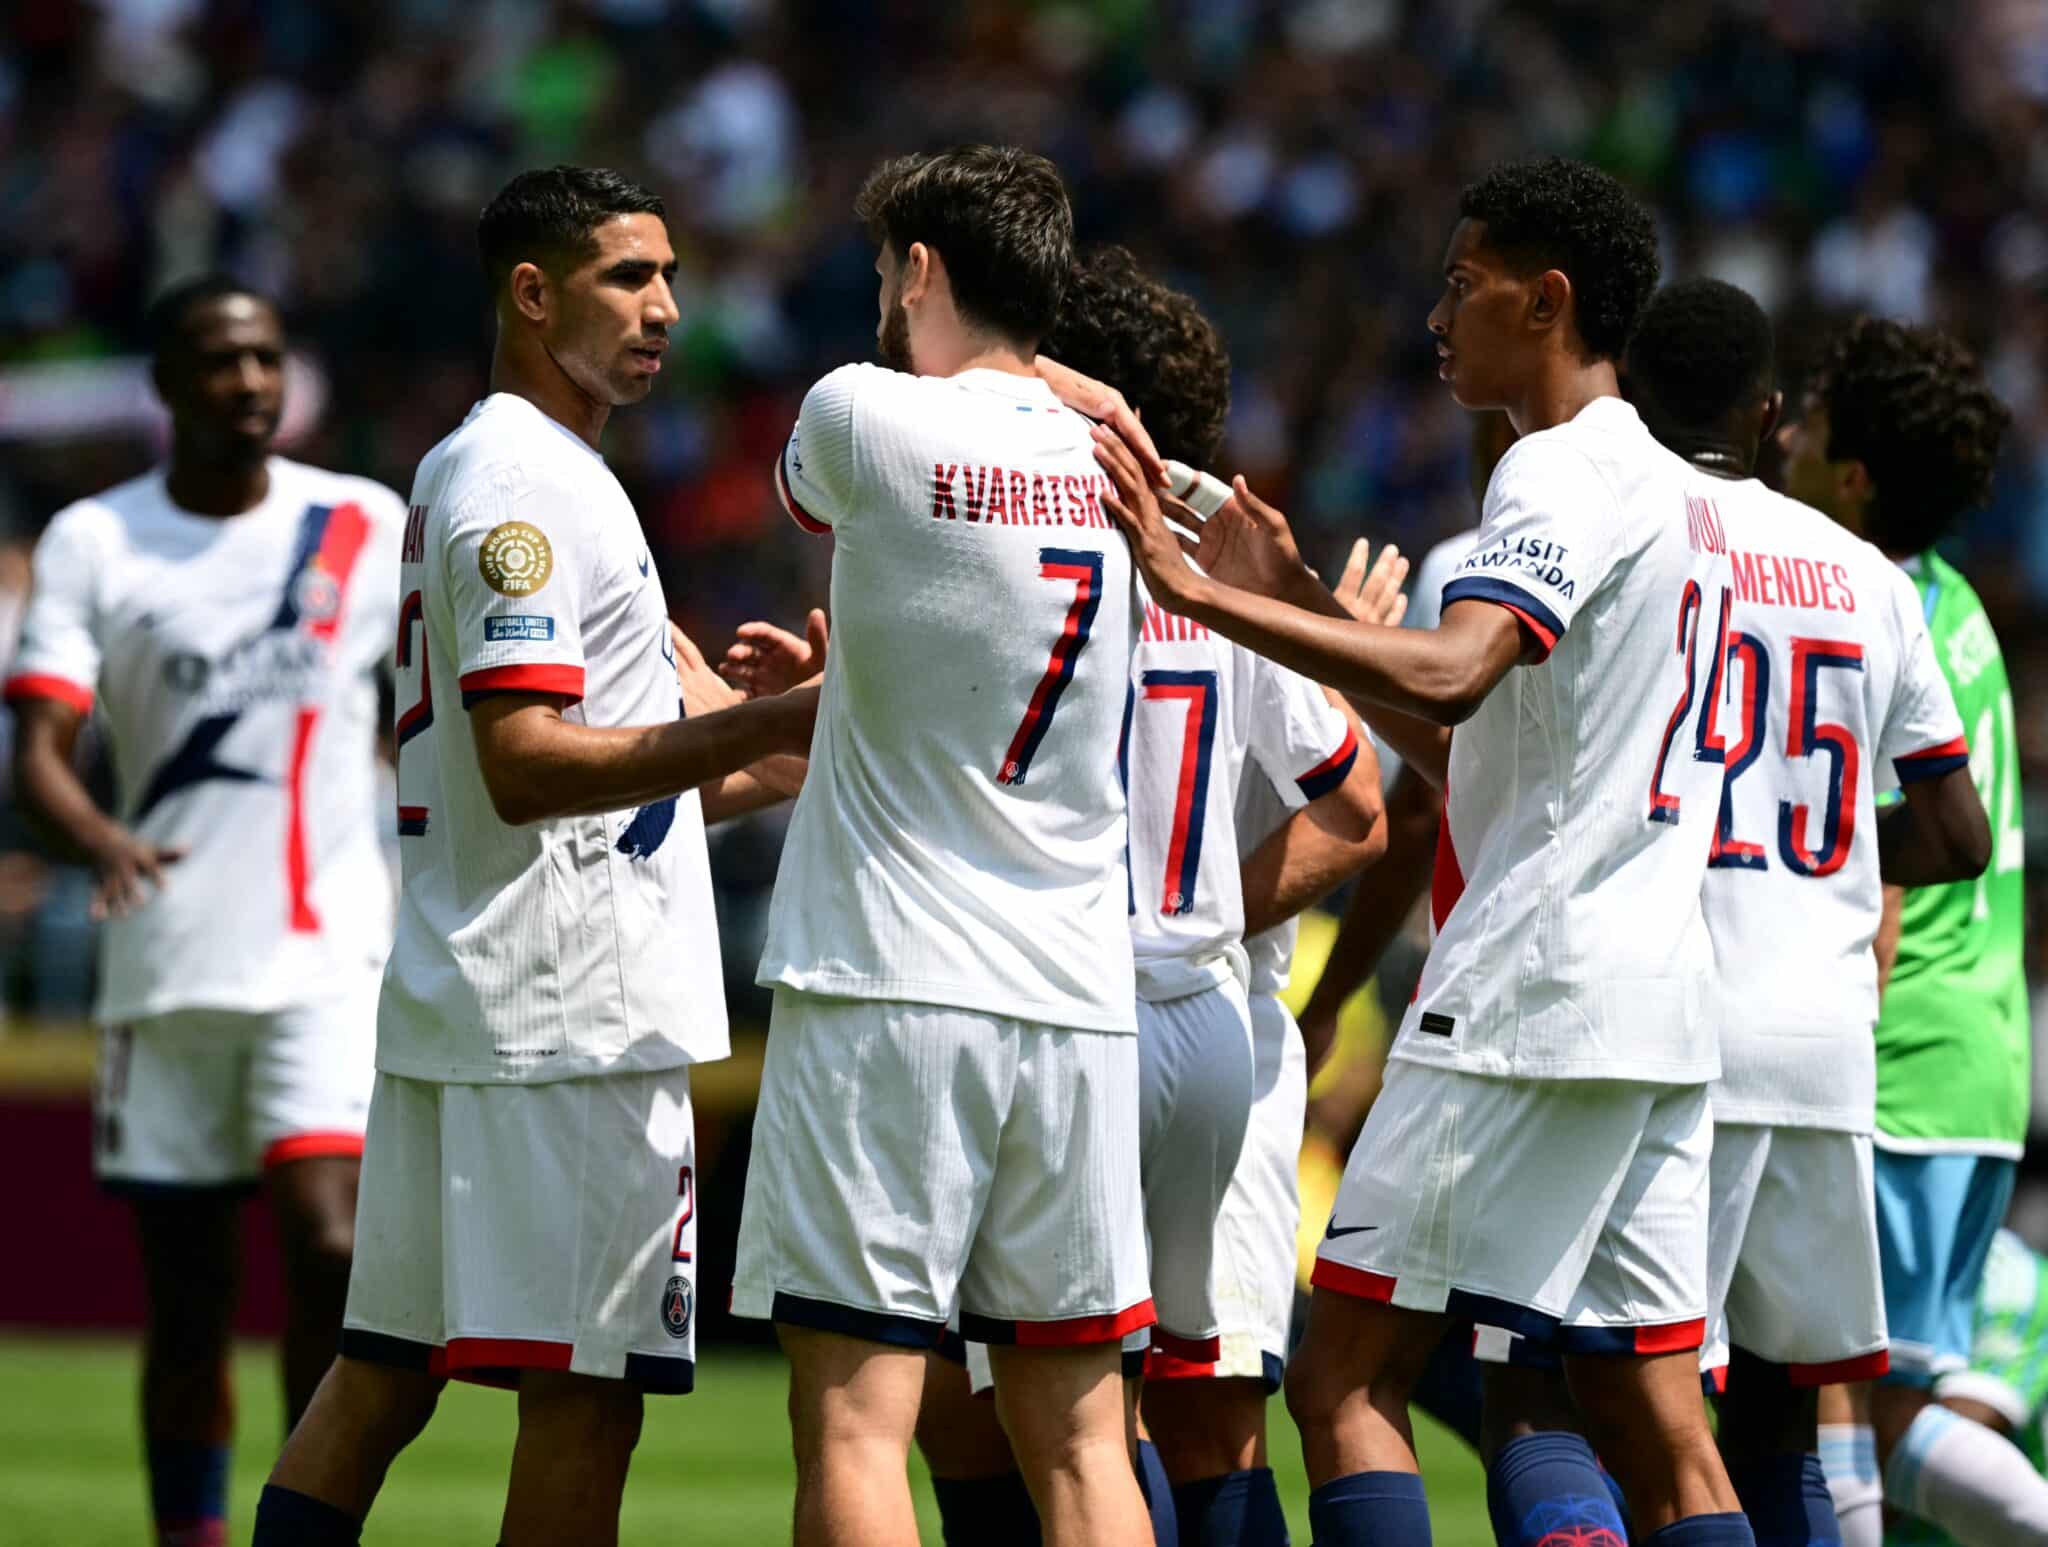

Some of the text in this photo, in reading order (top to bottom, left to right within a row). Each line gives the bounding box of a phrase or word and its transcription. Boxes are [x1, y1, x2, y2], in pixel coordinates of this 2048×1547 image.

[487, 528, 519, 552] WORLD
[503, 580, 531, 591] FIFA
[1730, 549, 1856, 613] MENDES
[996, 547, 1104, 786] 7
[1706, 631, 1866, 878] 25
[672, 1165, 693, 1263] 2
